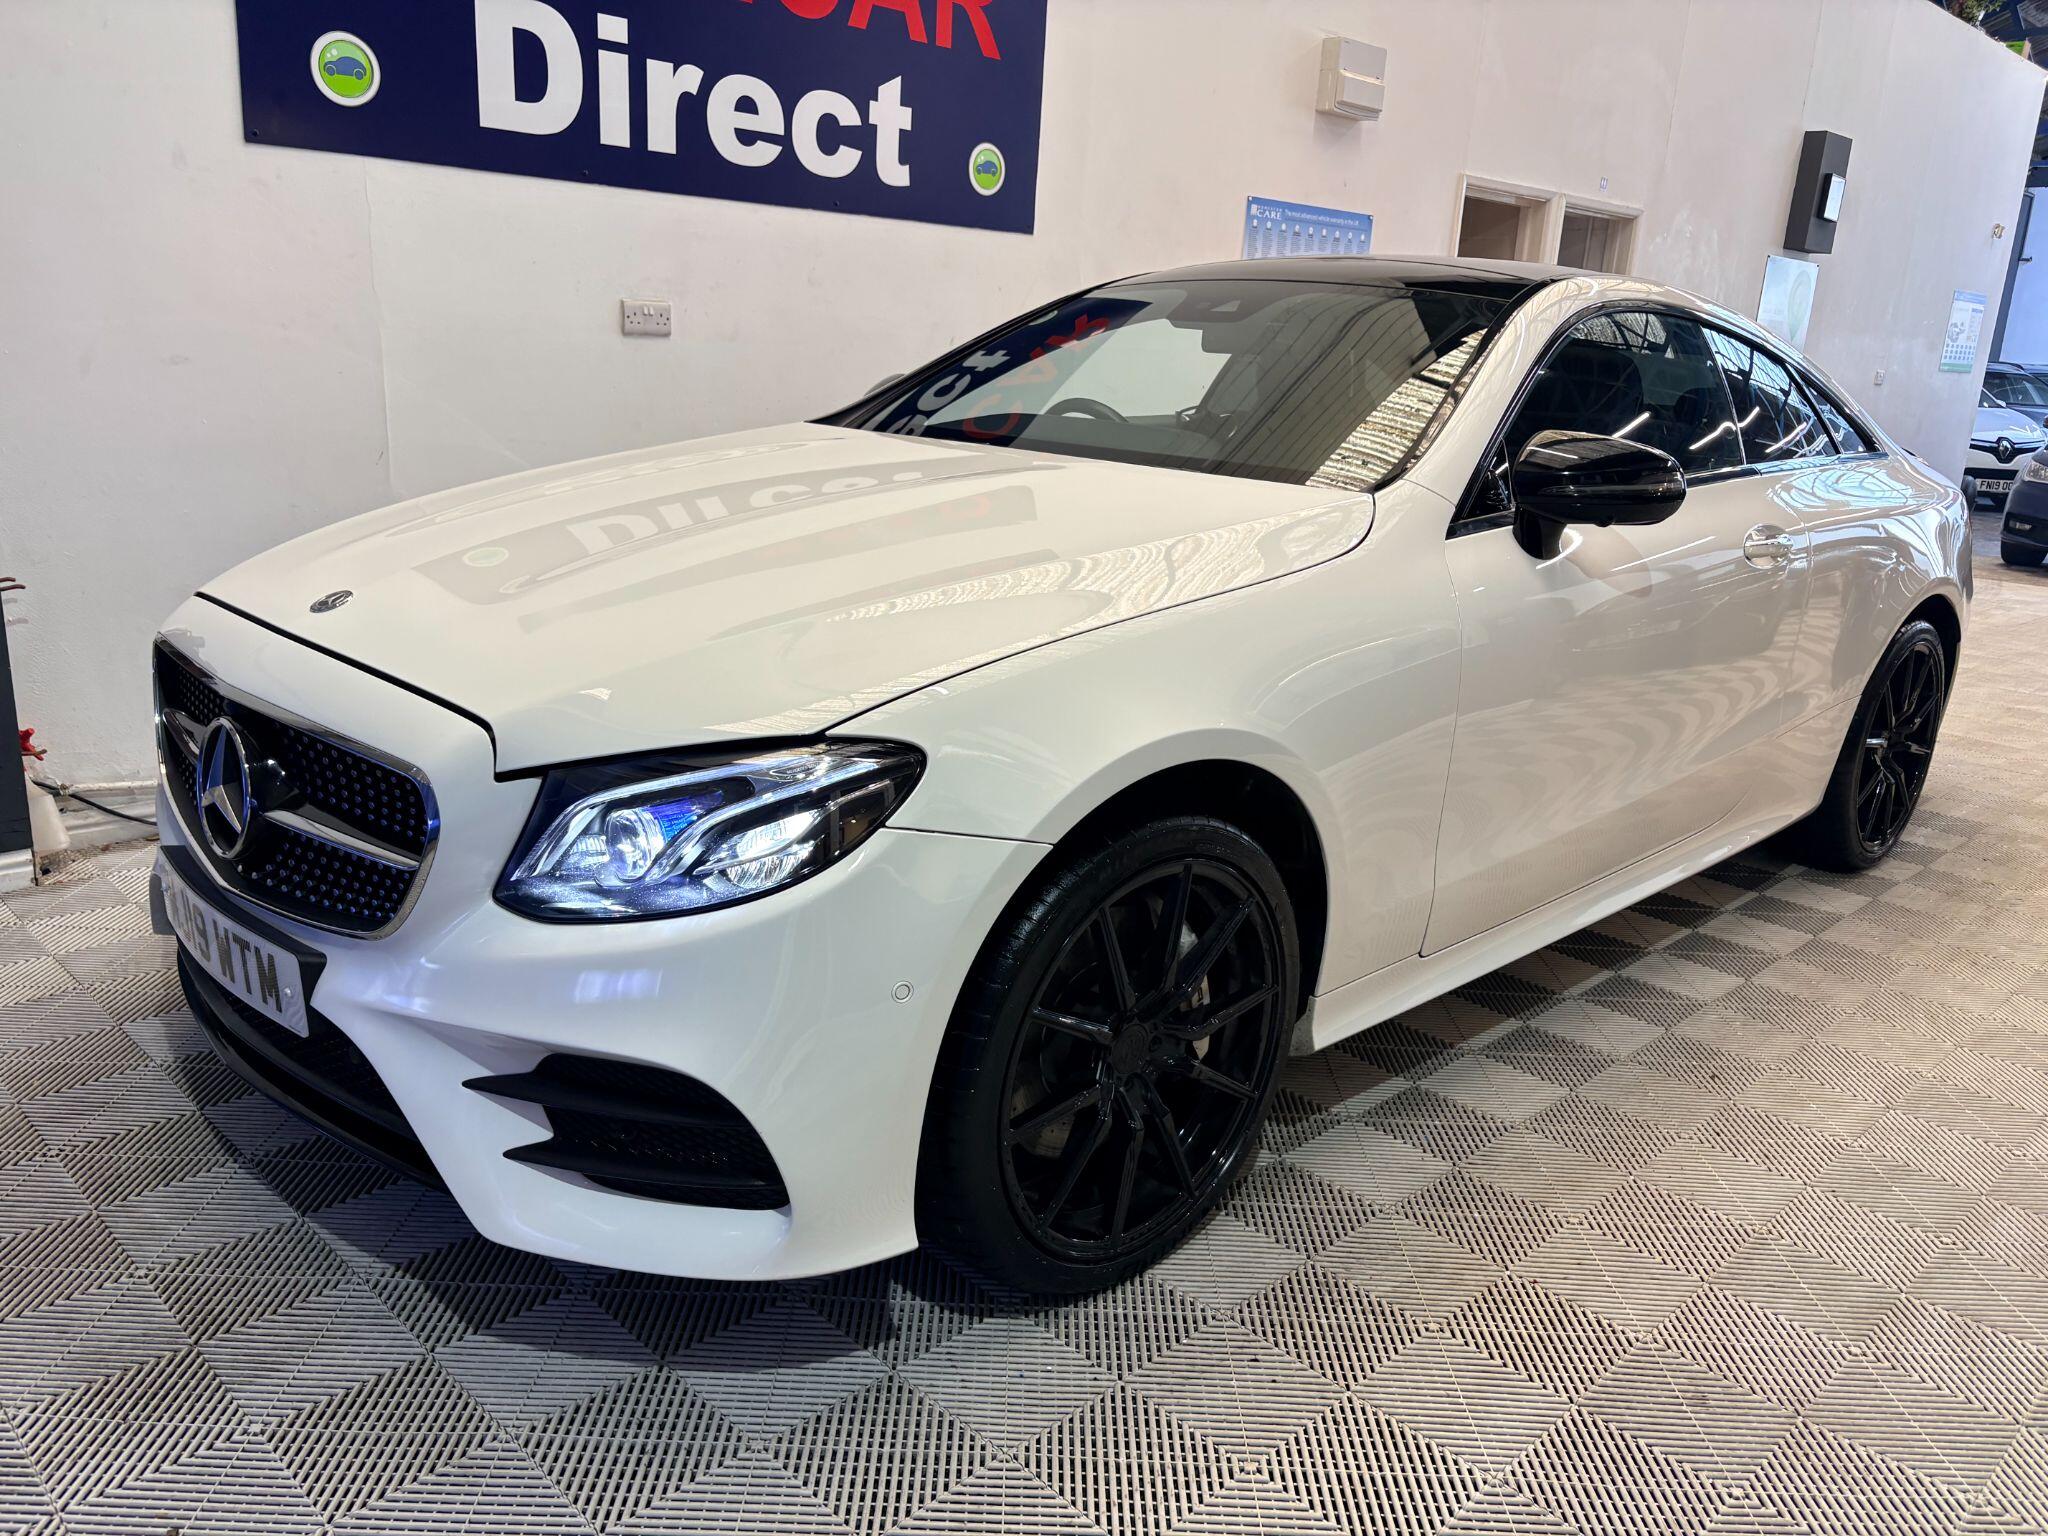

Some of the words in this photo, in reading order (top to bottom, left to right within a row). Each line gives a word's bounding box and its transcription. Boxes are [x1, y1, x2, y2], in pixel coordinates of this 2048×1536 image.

[474, 0, 912, 187] Direct
[1257, 209, 1282, 221] CARE
[1980, 480, 2001, 490] FN19
[212, 917, 283, 1014] WTM
